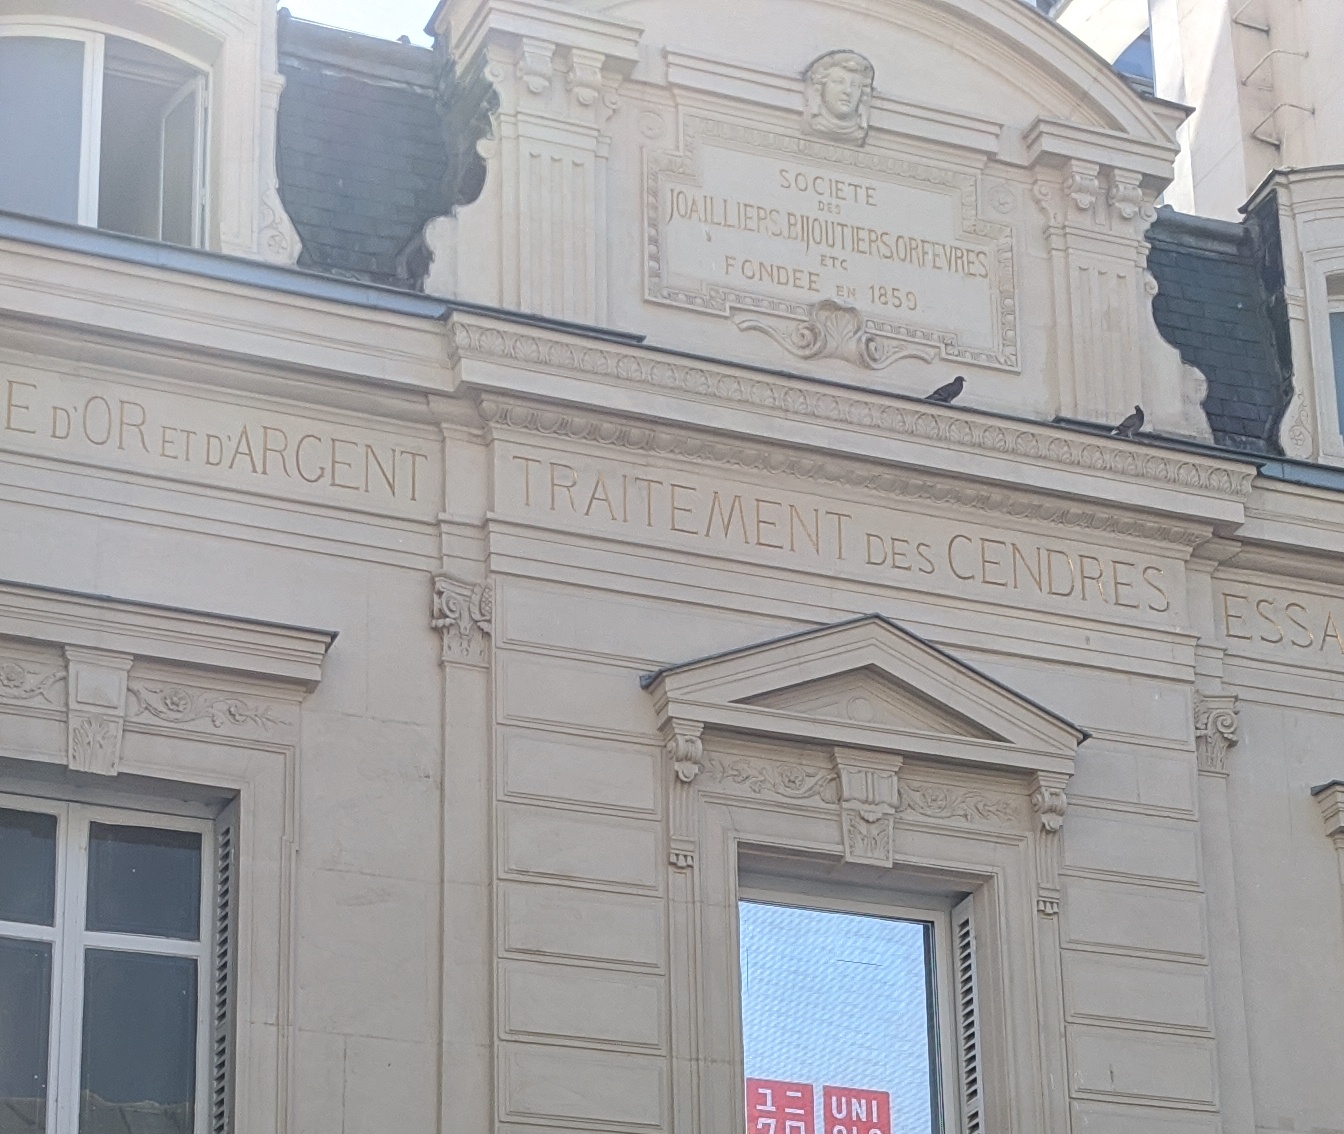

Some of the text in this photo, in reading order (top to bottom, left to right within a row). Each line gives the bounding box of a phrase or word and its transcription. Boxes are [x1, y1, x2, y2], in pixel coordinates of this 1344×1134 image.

[779, 168, 877, 207] SOCIETE
[817, 200, 841, 215] DES
[724, 254, 821, 293] FONDEE
[836, 285, 856, 299] EN
[820, 254, 849, 271] ETC
[159, 425, 199, 462] ET
[512, 455, 1172, 614] TRAITEMENT DES CENDRES
[830, 1095, 878, 1123] UNI
